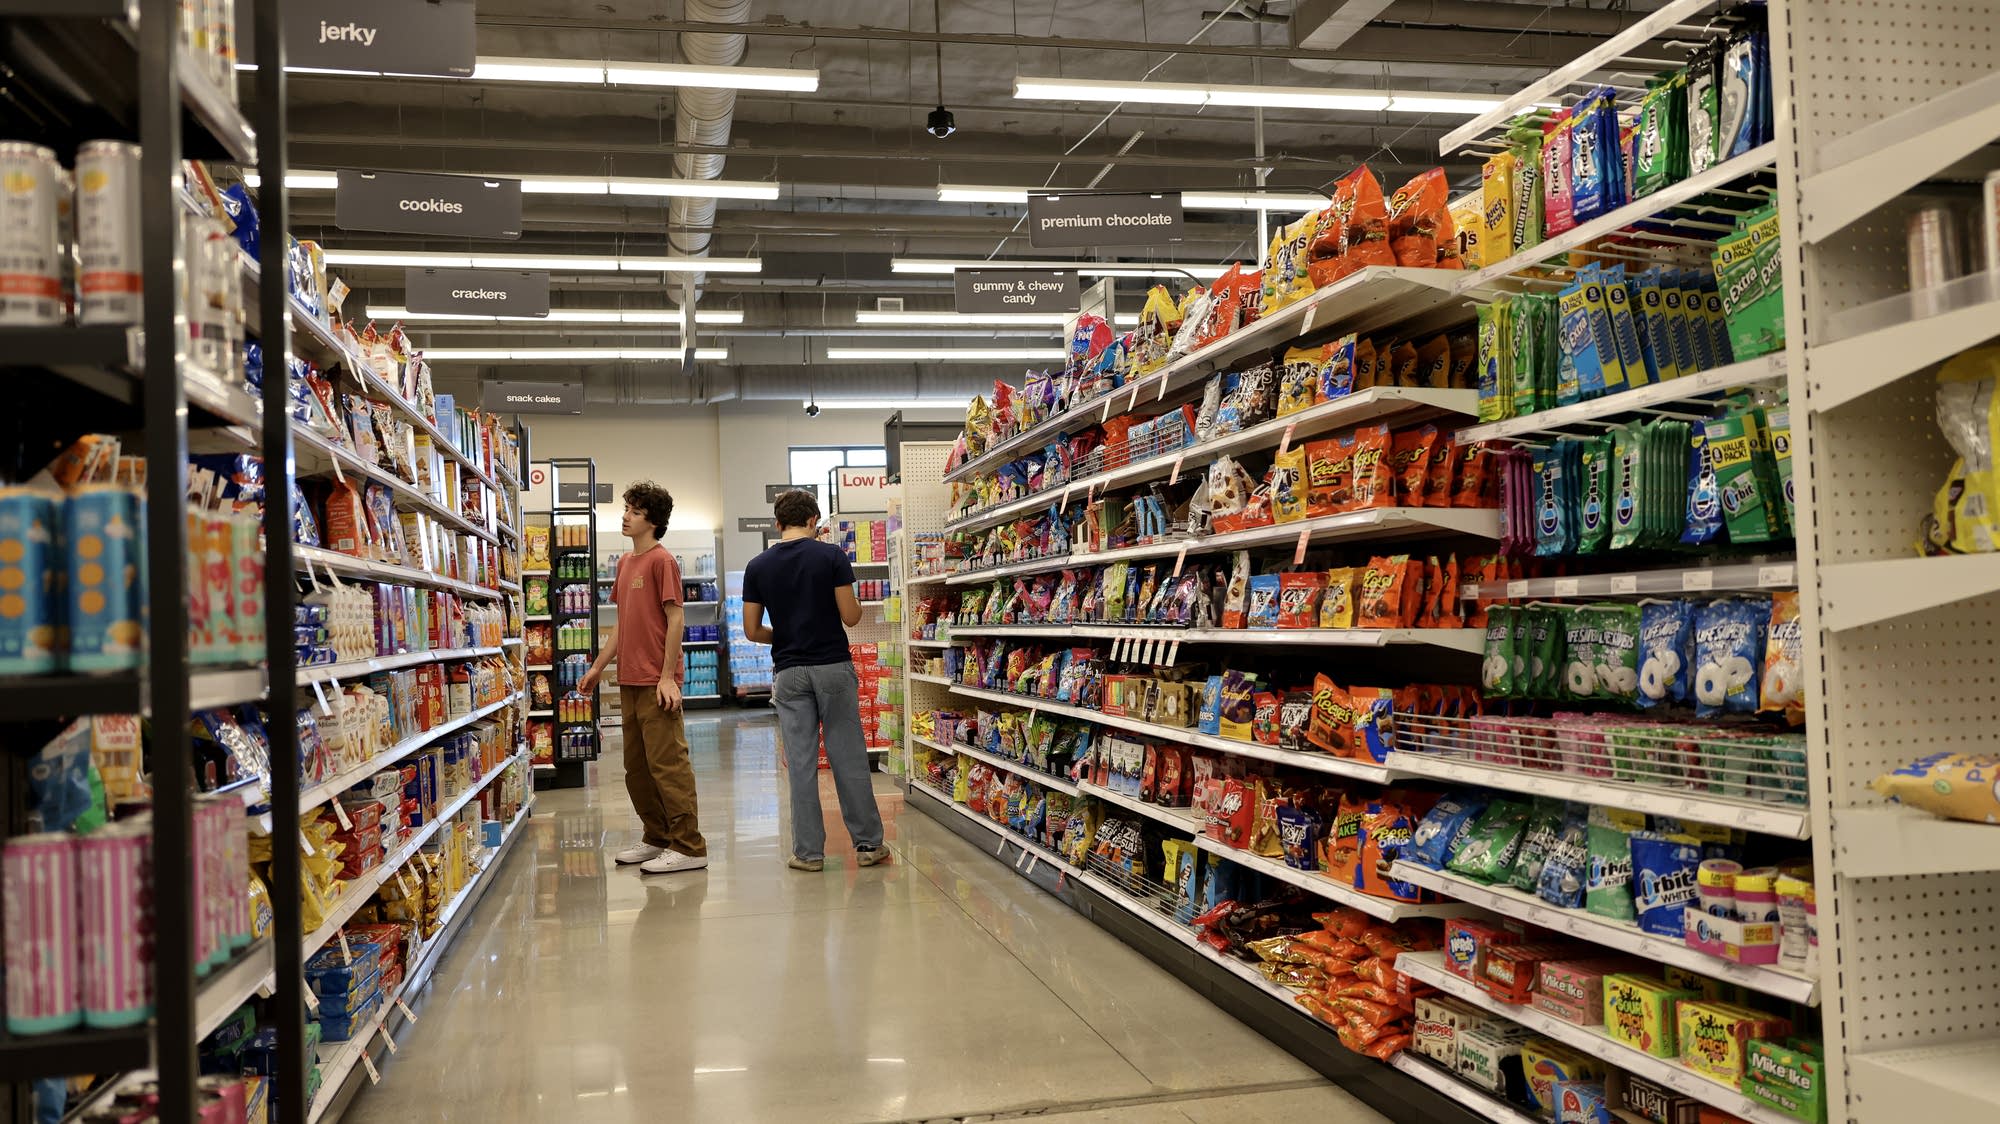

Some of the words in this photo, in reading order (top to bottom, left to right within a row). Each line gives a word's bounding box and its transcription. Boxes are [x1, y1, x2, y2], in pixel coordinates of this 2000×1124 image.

[319, 21, 377, 46] jerky
[1580, 128, 1588, 180] Trident
[1551, 147, 1560, 197] Trident
[399, 198, 463, 214] cookies
[1486, 197, 1502, 222] Juicy
[1515, 167, 1535, 246] DOUBLEMINT
[1041, 214, 1103, 230] premium
[1106, 212, 1172, 227] chocolate
[1489, 207, 1507, 231] Fruit
[1760, 218, 1777, 231] VALUE
[452, 286, 507, 301] crackers
[973, 281, 1014, 292] gummy
[1017, 281, 1026, 291] &
[1028, 280, 1064, 292] chewy
[1729, 266, 1757, 304] Extra
[1003, 292, 1037, 305] candy
[1512, 309, 1526, 360] Extra
[1569, 317, 1588, 348] Extra
[1480, 320, 1496, 366] Extra
[506, 393, 534, 404] snack
[535, 394, 561, 405] cakes
[1722, 440, 1745, 452] VALUE
[1724, 449, 1747, 462] PACK!
[843, 474, 875, 487] Low
[1691, 444, 1714, 520] Obit
[1723, 482, 1754, 514] Orbit
[1313, 689, 1351, 724] Reese's
[1338, 824, 1357, 838] AKE
[1640, 868, 1694, 905] Orbit
[1661, 888, 1697, 903] WHITE
[1697, 919, 1722, 943] Orbit
[1450, 937, 1475, 953] Nerds
[1541, 973, 1566, 991] Mike
[1567, 983, 1584, 999] Ike
[1616, 999, 1642, 1014] SOUR
[1417, 1022, 1454, 1039] WHOPPERS
[1617, 1012, 1645, 1030] PATCH
[1696, 1025, 1726, 1042] SOUR
[1459, 1043, 1489, 1066] Junior
[1697, 1038, 1729, 1054] PATCH
[1476, 1063, 1495, 1081] Mints
[1752, 1052, 1786, 1076] Mike
[1788, 1070, 1811, 1090] Ike
[1754, 1084, 1778, 1101] Mike
[1779, 1095, 1798, 1111] Ike
